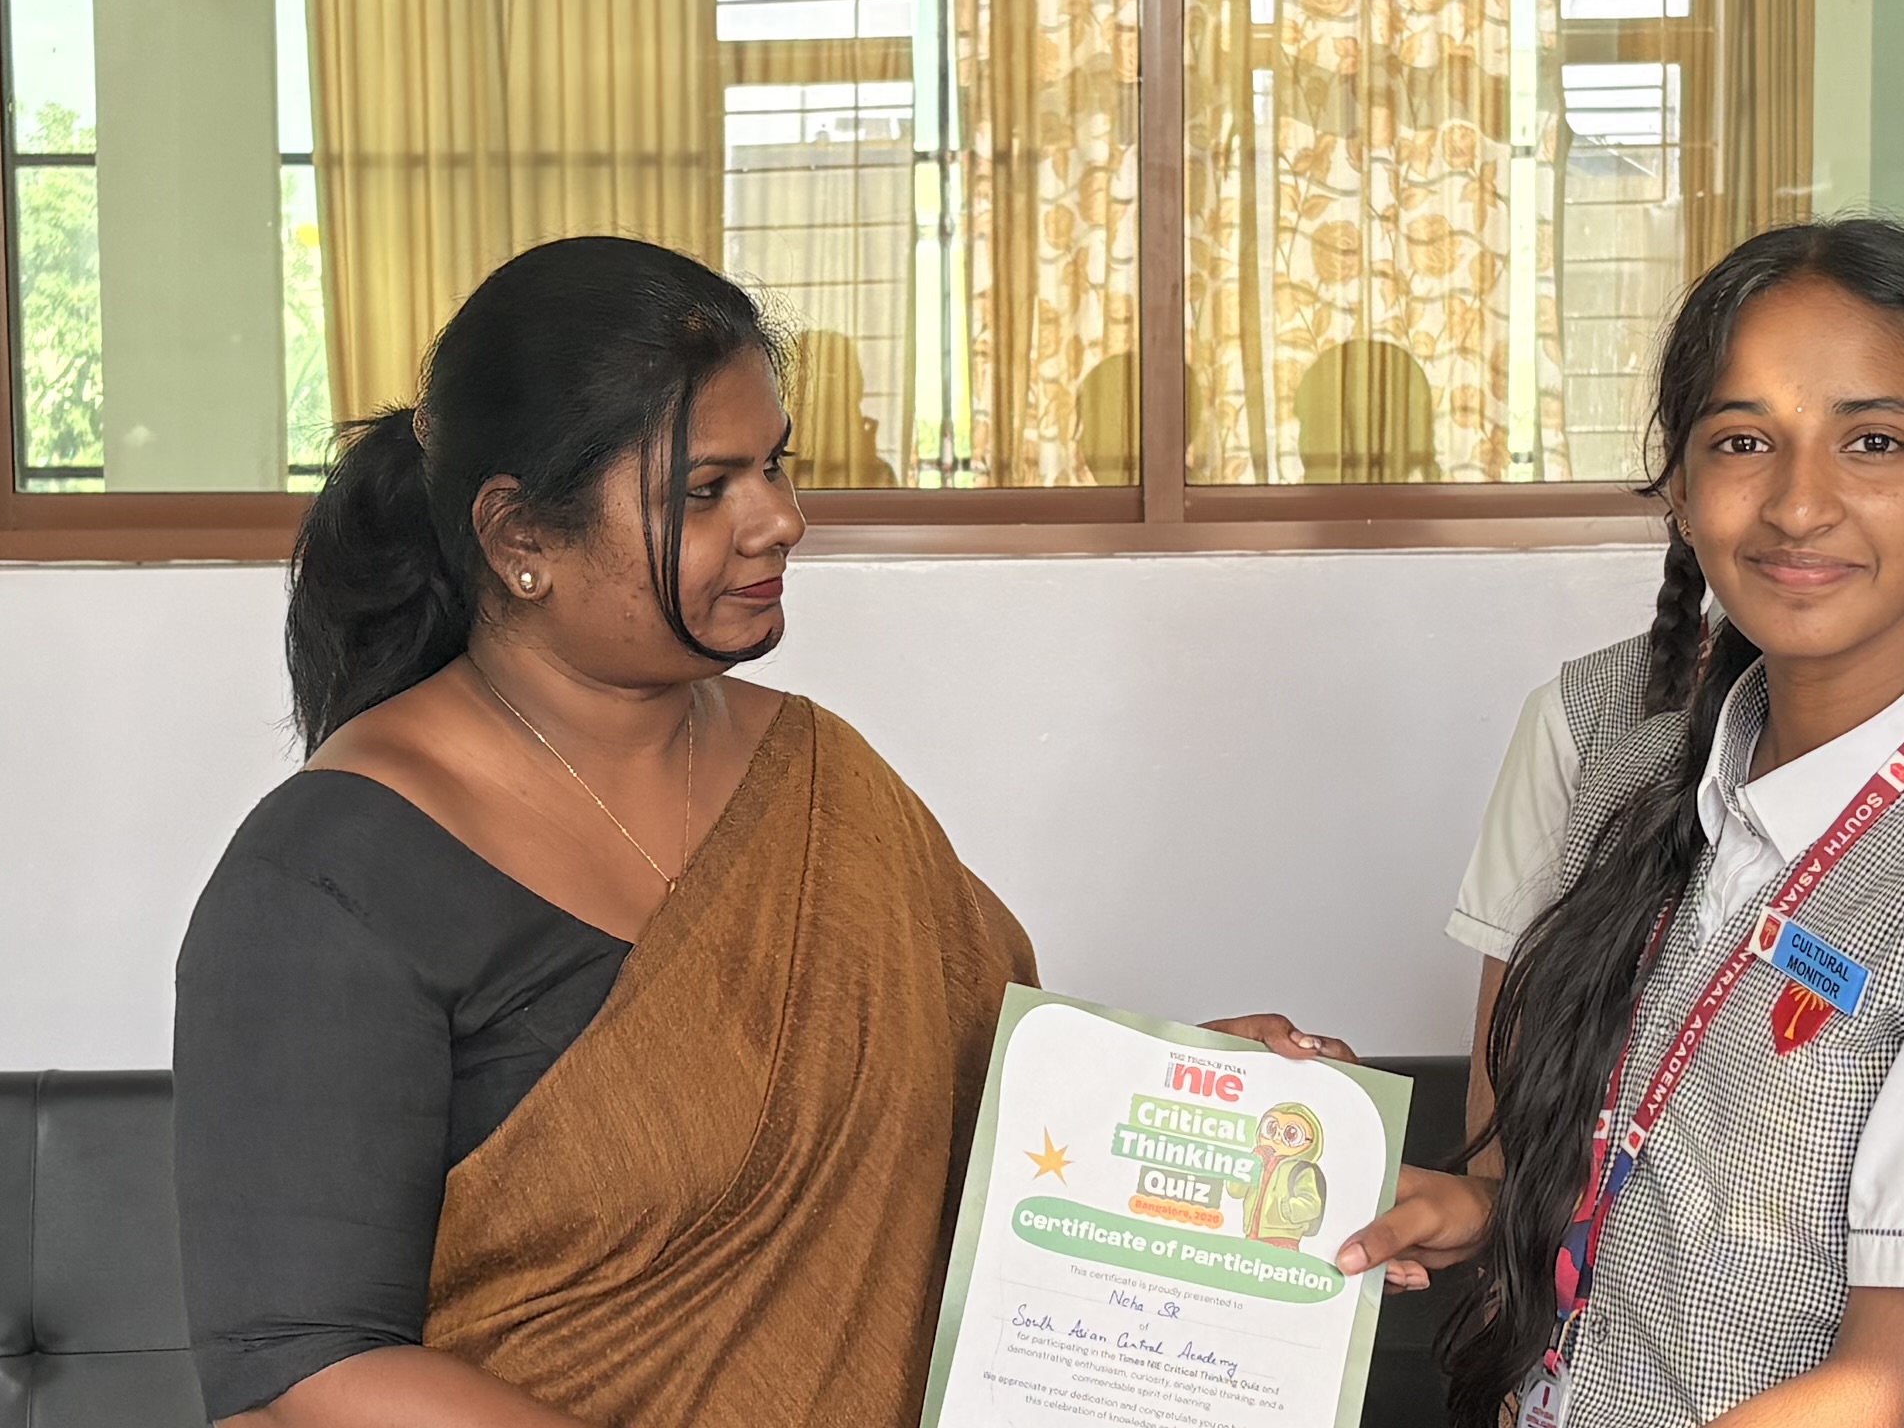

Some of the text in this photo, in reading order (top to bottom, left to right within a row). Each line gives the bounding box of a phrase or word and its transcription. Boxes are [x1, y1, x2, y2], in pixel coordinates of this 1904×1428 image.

[1646, 792, 1883, 1116] SOUTH ASIAN NTRAL ACADEMY
[1787, 955, 1840, 999] MONITOR
[1792, 933, 1849, 982] CULTURAL
[1137, 1102, 1246, 1142] Critical
[1119, 1130, 1254, 1183] Thinking
[1144, 1170, 1211, 1203] Quiz
[1020, 1209, 1332, 1292] Certificate of Participation
[1070, 1265, 1243, 1310] This certificate is proudly presented to
[1109, 1290, 1182, 1319] Neha SR
[1012, 1304, 1054, 1331] South
[1068, 1319, 1107, 1342] Asian
[1178, 1341, 1238, 1378] Academy
[1017, 1331, 1030, 1341] for
[1032, 1337, 1089, 1356] participating
[1091, 1347, 1099, 1356] in
[1100, 1348, 1116, 1360] the
[1119, 1354, 1144, 1366] Times
[1164, 1362, 1198, 1378] Critical
[1201, 1370, 1238, 1388] Thinking
[1262, 1385, 1279, 1395] and
[983, 1371, 996, 1381] We
[999, 1374, 1046, 1392] appreciate
[1048, 1386, 1068, 1398] your
[1071, 1391, 1118, 1407] dedication
[1120, 1401, 1137, 1412] and
[1139, 1403, 1198, 1424] congratulate
[1008, 1345, 1073, 1367] demonstrating
[1075, 1361, 1128, 1377] enthusiasm,
[1174, 1380, 1218, 1396] analytical
[1259, 1398, 1276, 1409] and
[1072, 1374, 1211, 1411] commendable spirit of learning
[1026, 1396, 1042, 1406] this
[1044, 1400, 1095, 1417] celebration
[1097, 1409, 1108, 1419] of
